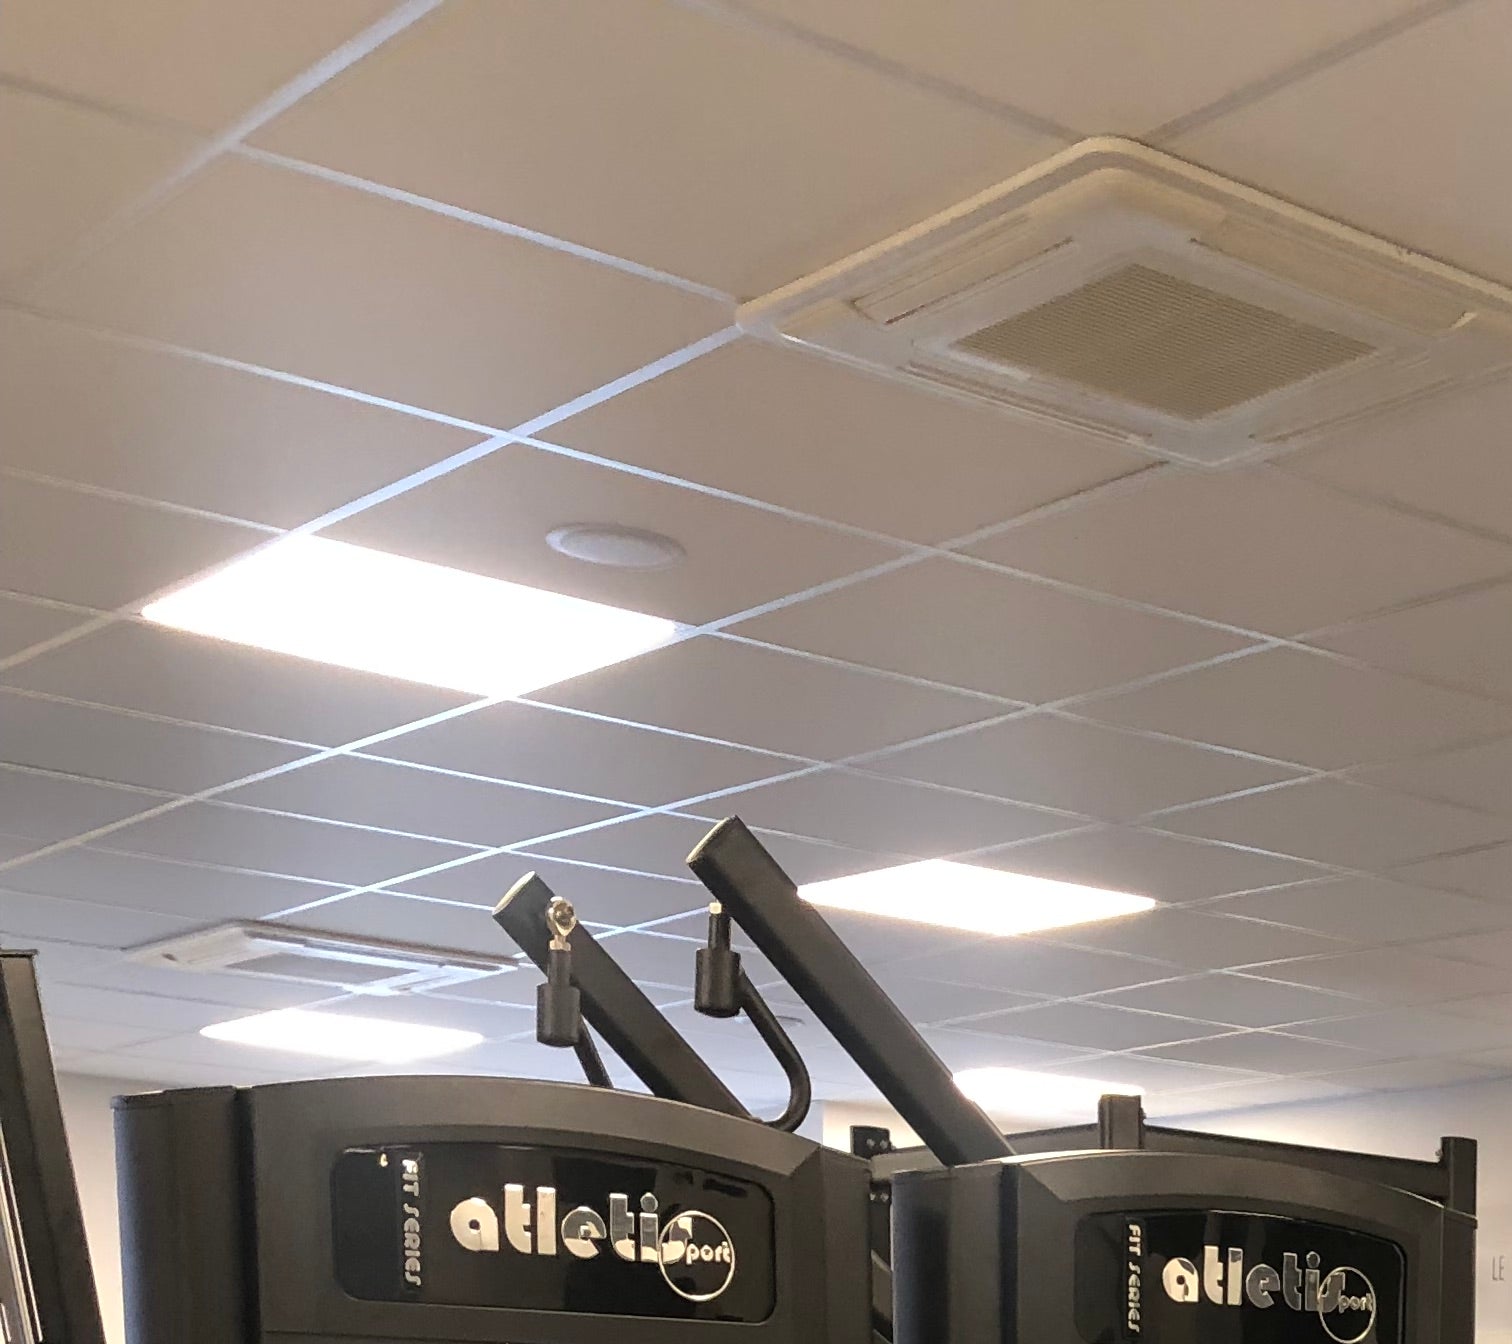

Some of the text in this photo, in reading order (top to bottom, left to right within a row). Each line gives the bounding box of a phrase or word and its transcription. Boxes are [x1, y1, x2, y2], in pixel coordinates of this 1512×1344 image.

[402, 1159, 421, 1286] FIT SERIES
[1492, 1255, 1505, 1281] LE
[1127, 1223, 1141, 1333] FIT SERIES
